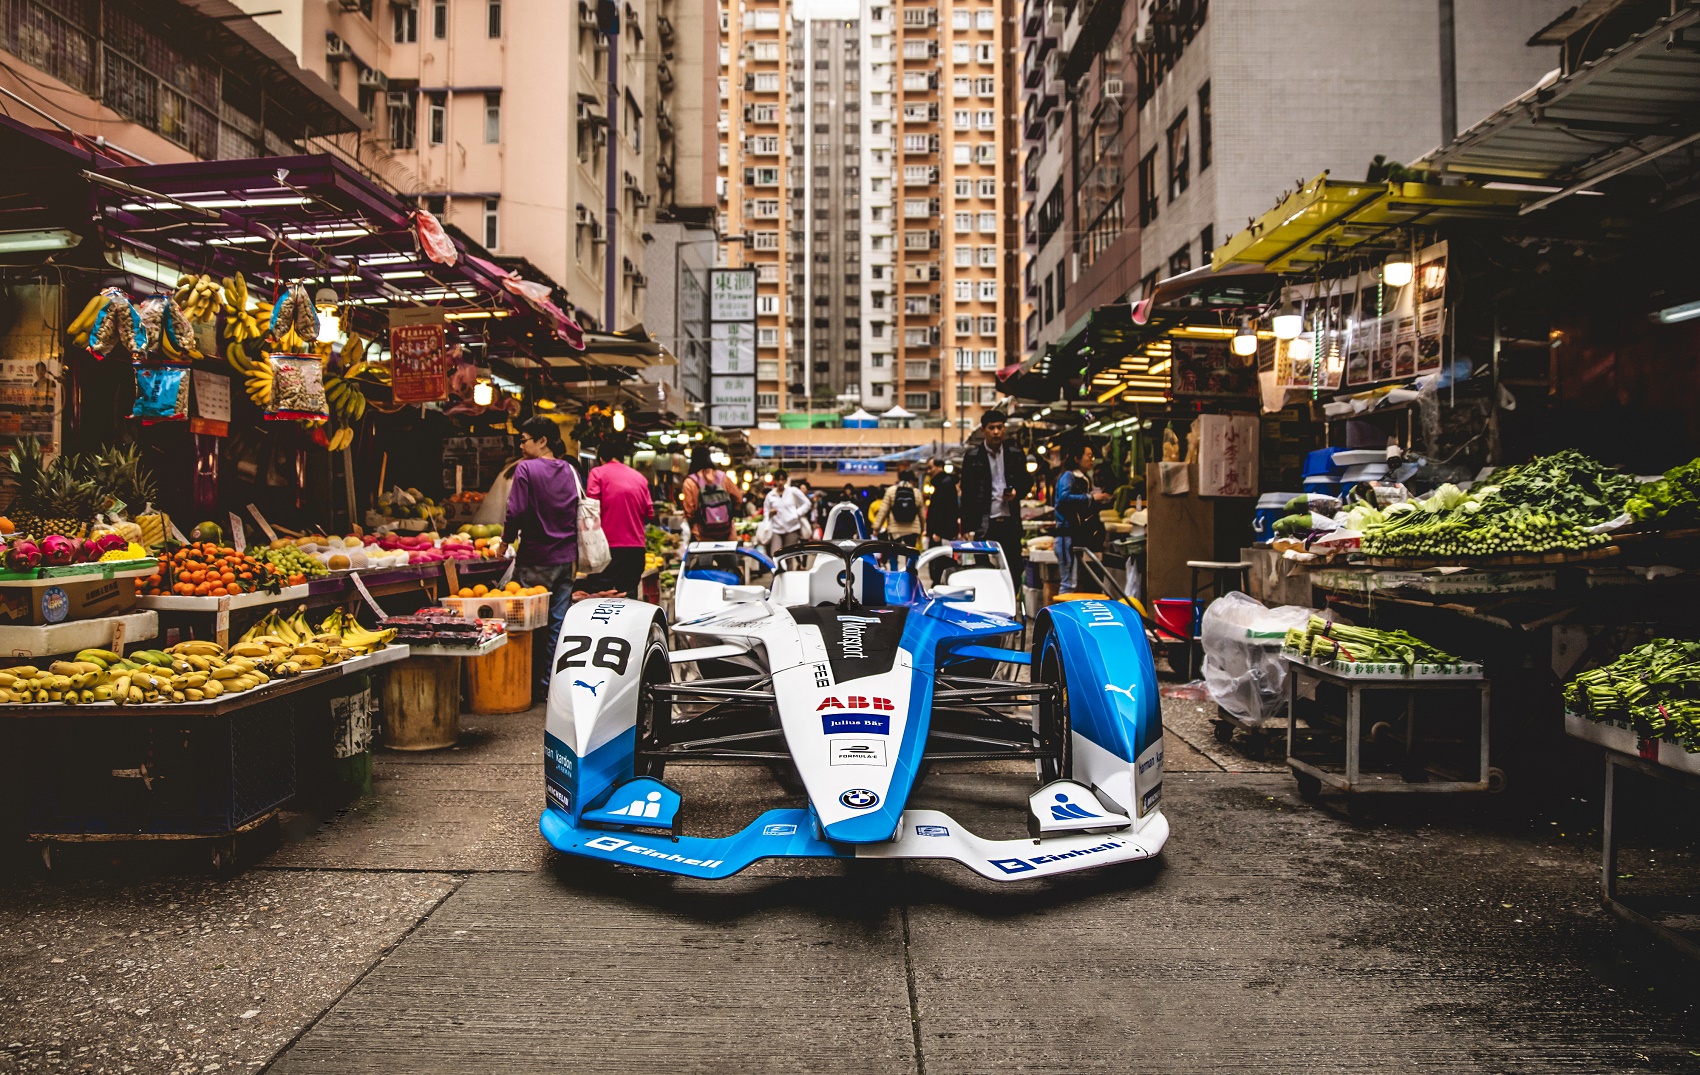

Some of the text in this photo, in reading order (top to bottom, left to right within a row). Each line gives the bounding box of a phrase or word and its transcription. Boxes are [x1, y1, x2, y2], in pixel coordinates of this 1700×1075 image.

[837, 622, 869, 659] Motorsport
[556, 635, 632, 677] 28
[816, 695, 896, 711] ABB
[623, 844, 724, 869] Einhell
[1027, 841, 1123, 865] Einhell
